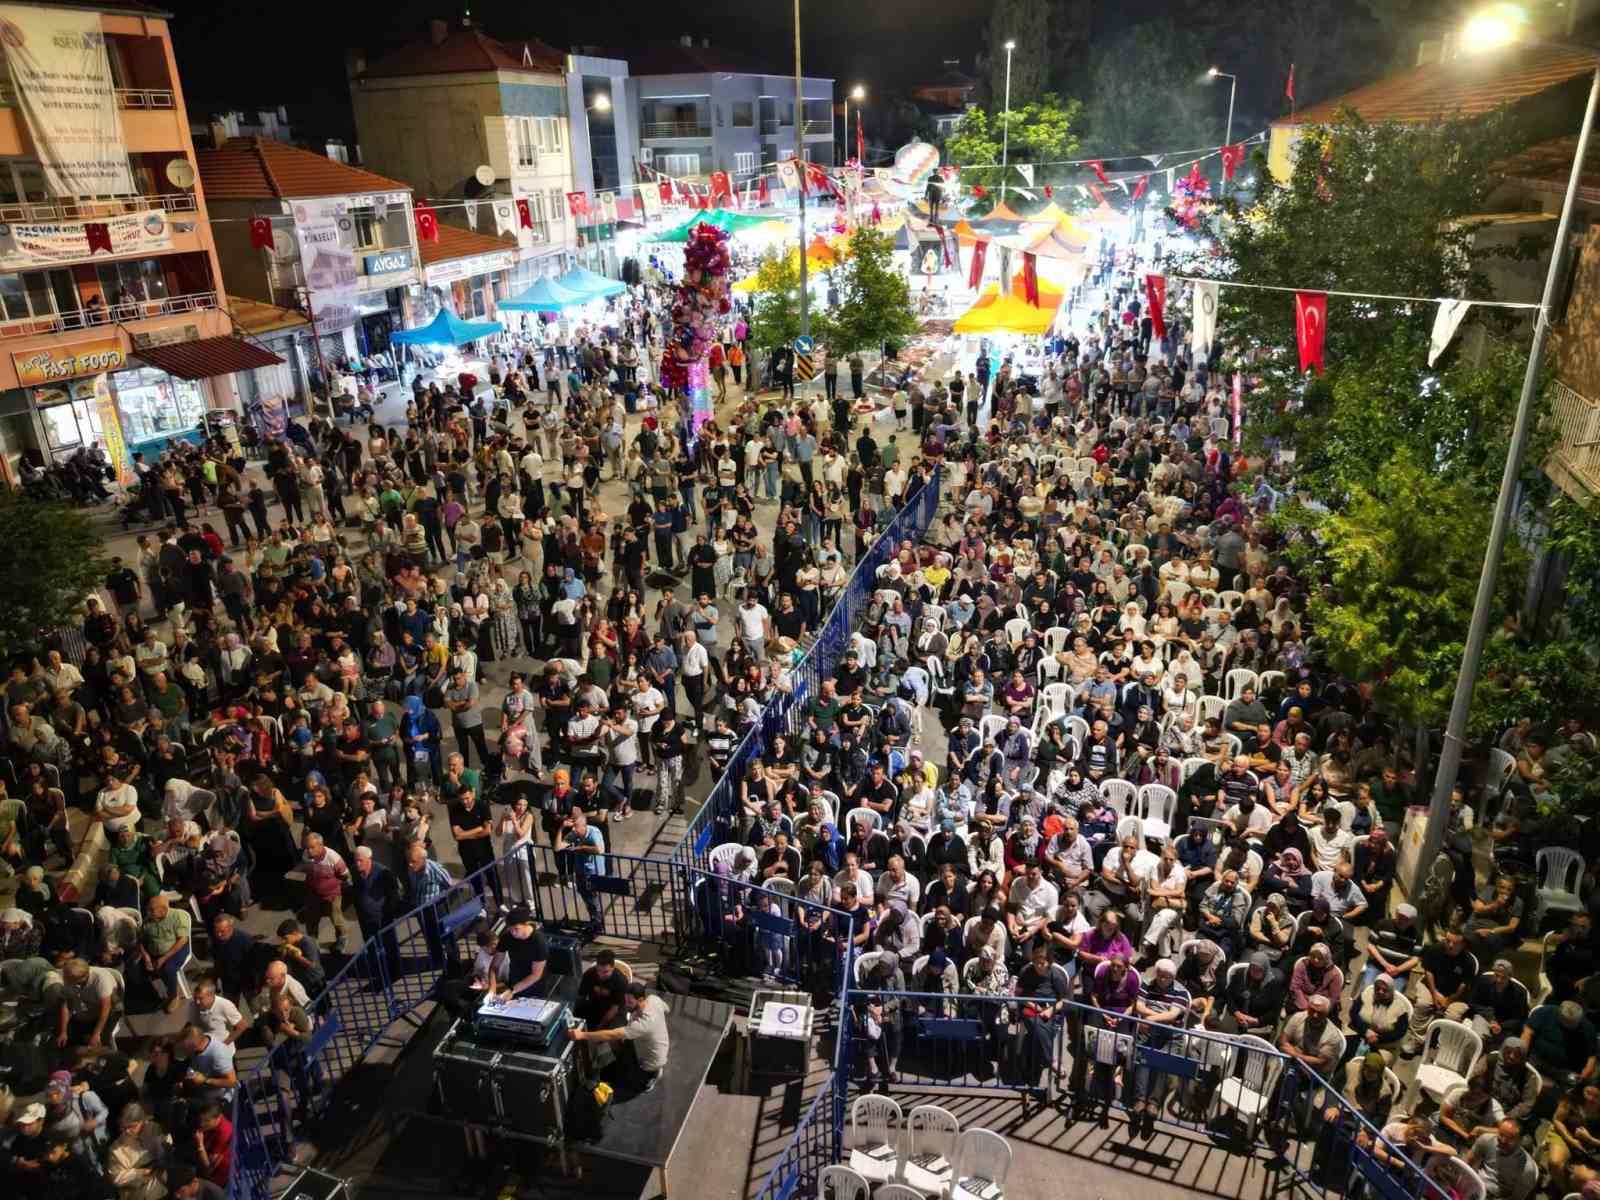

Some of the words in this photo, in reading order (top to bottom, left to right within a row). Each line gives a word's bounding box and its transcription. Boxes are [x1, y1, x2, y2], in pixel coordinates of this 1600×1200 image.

[373, 254, 407, 274] AYGAZ
[41, 358, 77, 378] FAST
[80, 350, 121, 371] FOOD
